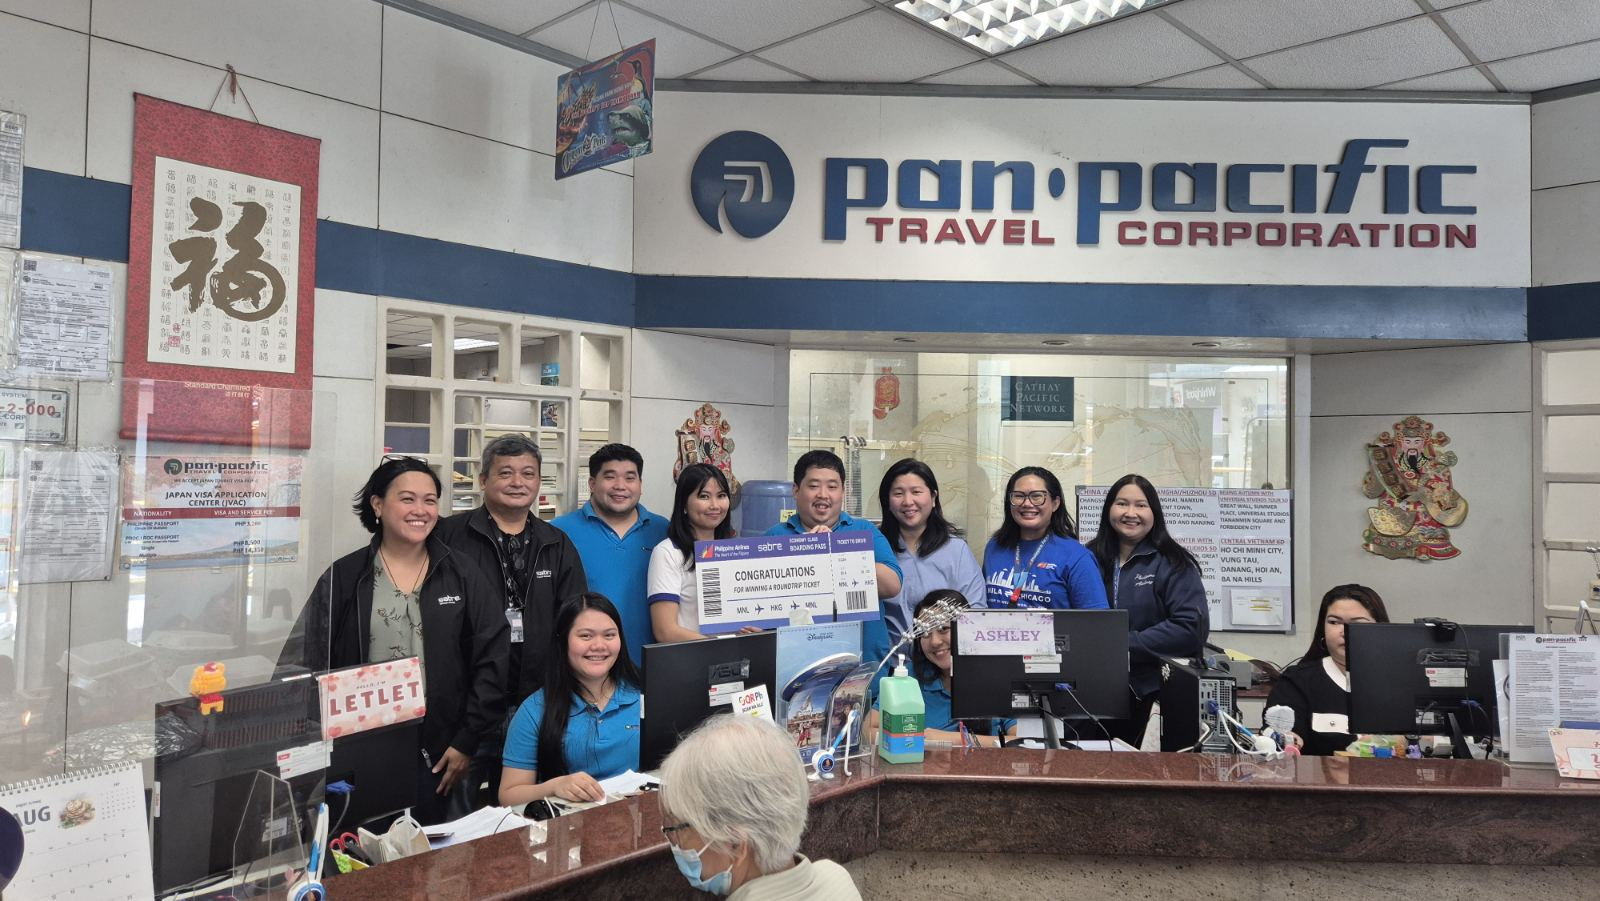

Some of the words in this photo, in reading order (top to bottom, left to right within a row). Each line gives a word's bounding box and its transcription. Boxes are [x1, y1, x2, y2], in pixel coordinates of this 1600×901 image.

[866, 217, 1055, 245] TRAVEL
[1118, 220, 1477, 249] CORPORATION
[168, 196, 286, 322] 福
[1015, 381, 1061, 392] CATHAY
[1016, 392, 1060, 402] PACIFIC
[1010, 403, 1066, 413] NETWORK
[165, 491, 193, 500] JAPAN
[188, 499, 220, 507] CENTER
[221, 499, 247, 507] (JVAC)
[758, 542, 783, 552] sabre
[790, 544, 814, 552] BOARDING
[1267, 547, 1284, 555] CITY,
[734, 566, 816, 582] CONGRATULATIONS
[1221, 566, 1254, 574] DANANG,
[1255, 566, 1268, 574] HOI
[733, 586, 745, 594] FOR
[745, 584, 768, 592] WINNING
[773, 582, 802, 590] ROUNDTRIP
[803, 580, 821, 588] TICKET
[1019, 593, 1051, 603] HICAGO
[737, 606, 750, 614] MNL
[770, 603, 783, 612] HKG
[974, 630, 1041, 642] ASHLEY
[329, 681, 420, 717] LETLET
